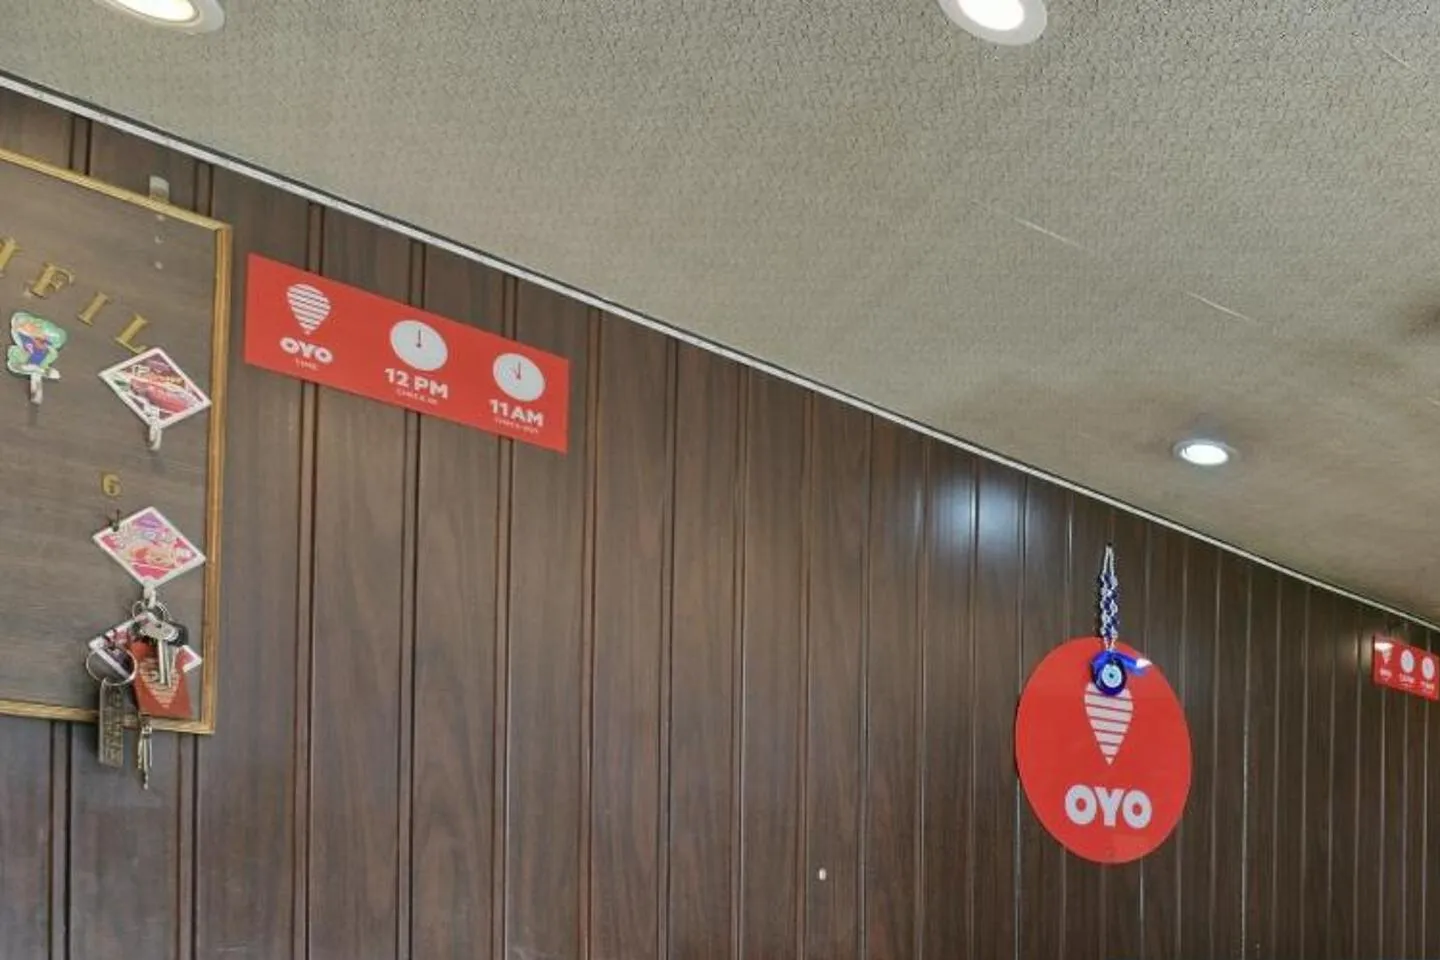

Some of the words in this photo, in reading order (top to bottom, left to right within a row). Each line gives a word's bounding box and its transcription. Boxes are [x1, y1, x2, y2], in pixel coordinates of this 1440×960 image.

[280, 337, 333, 364] OYO
[384, 368, 409, 388] 12
[414, 376, 449, 399] PM
[489, 399, 509, 417] 11
[511, 407, 544, 427] AM
[1064, 783, 1153, 830] OYO
